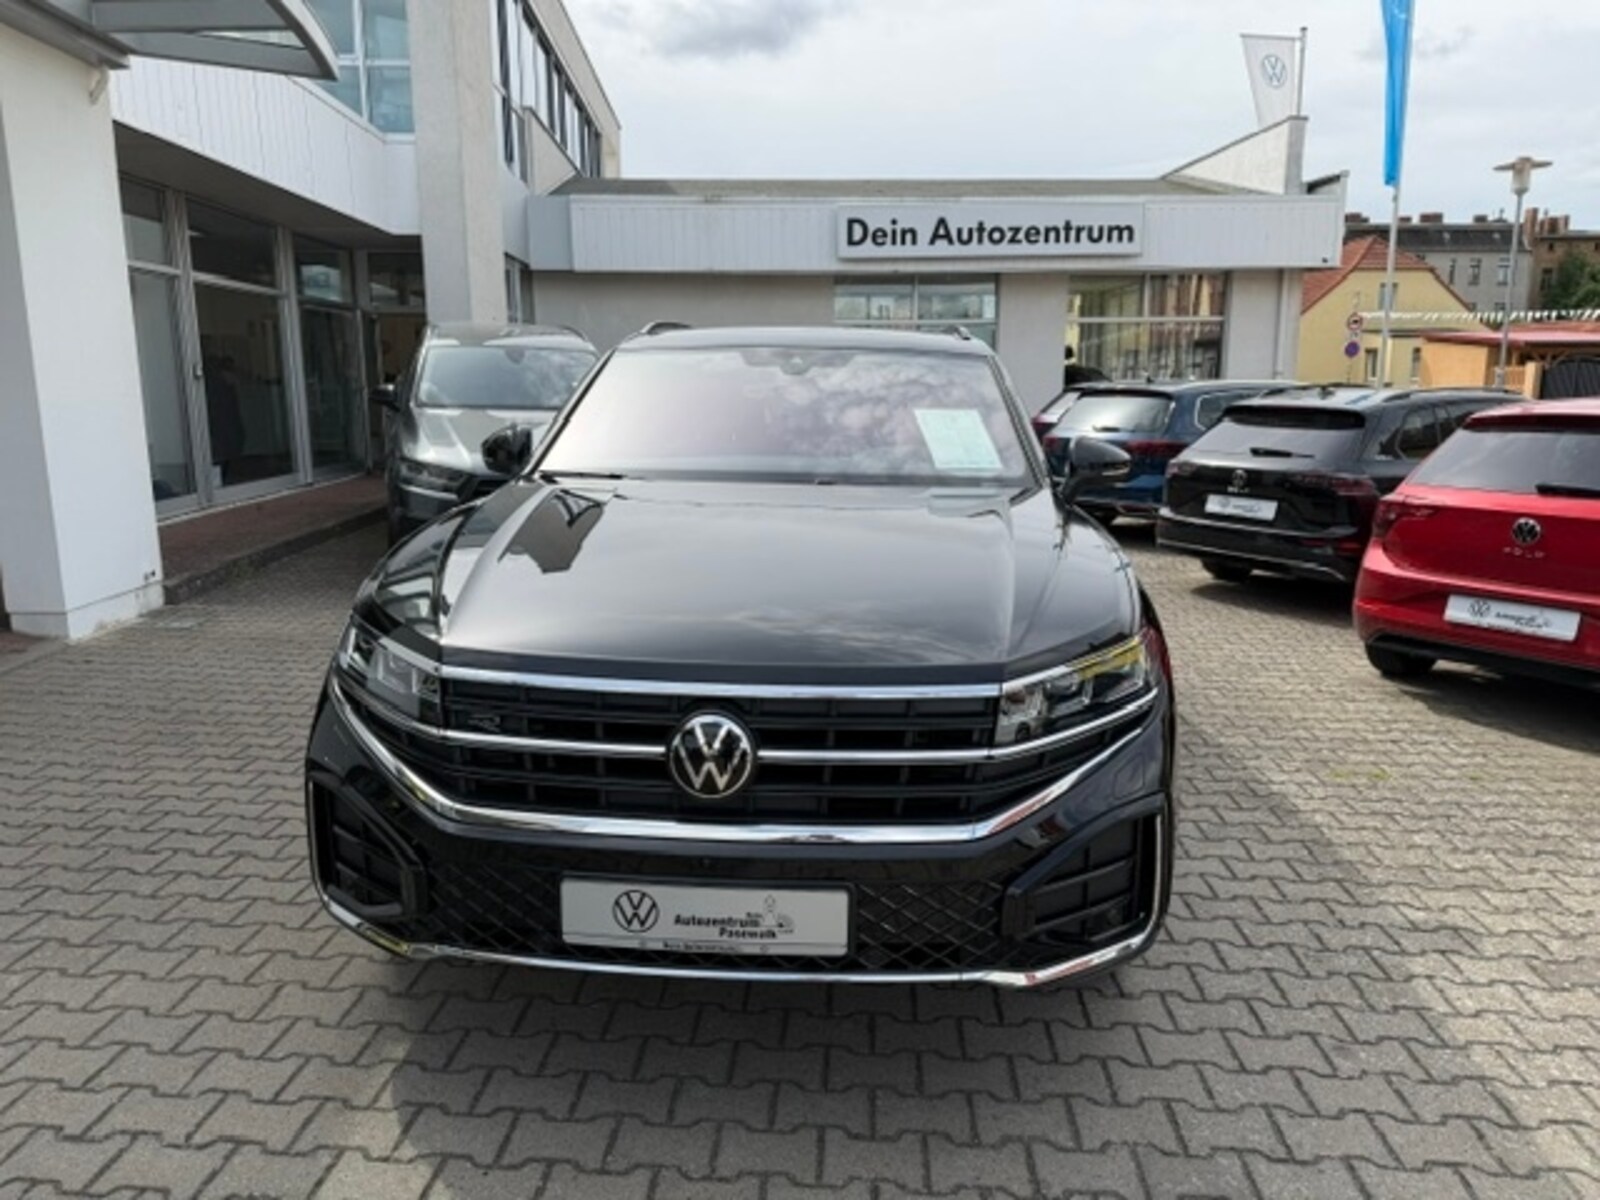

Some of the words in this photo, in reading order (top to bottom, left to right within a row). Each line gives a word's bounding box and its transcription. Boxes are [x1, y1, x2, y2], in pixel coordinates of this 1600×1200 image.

[847, 218, 918, 247] Dein
[929, 217, 1135, 246] Autozentrum
[670, 715, 751, 797] VW
[613, 890, 659, 932] VW
